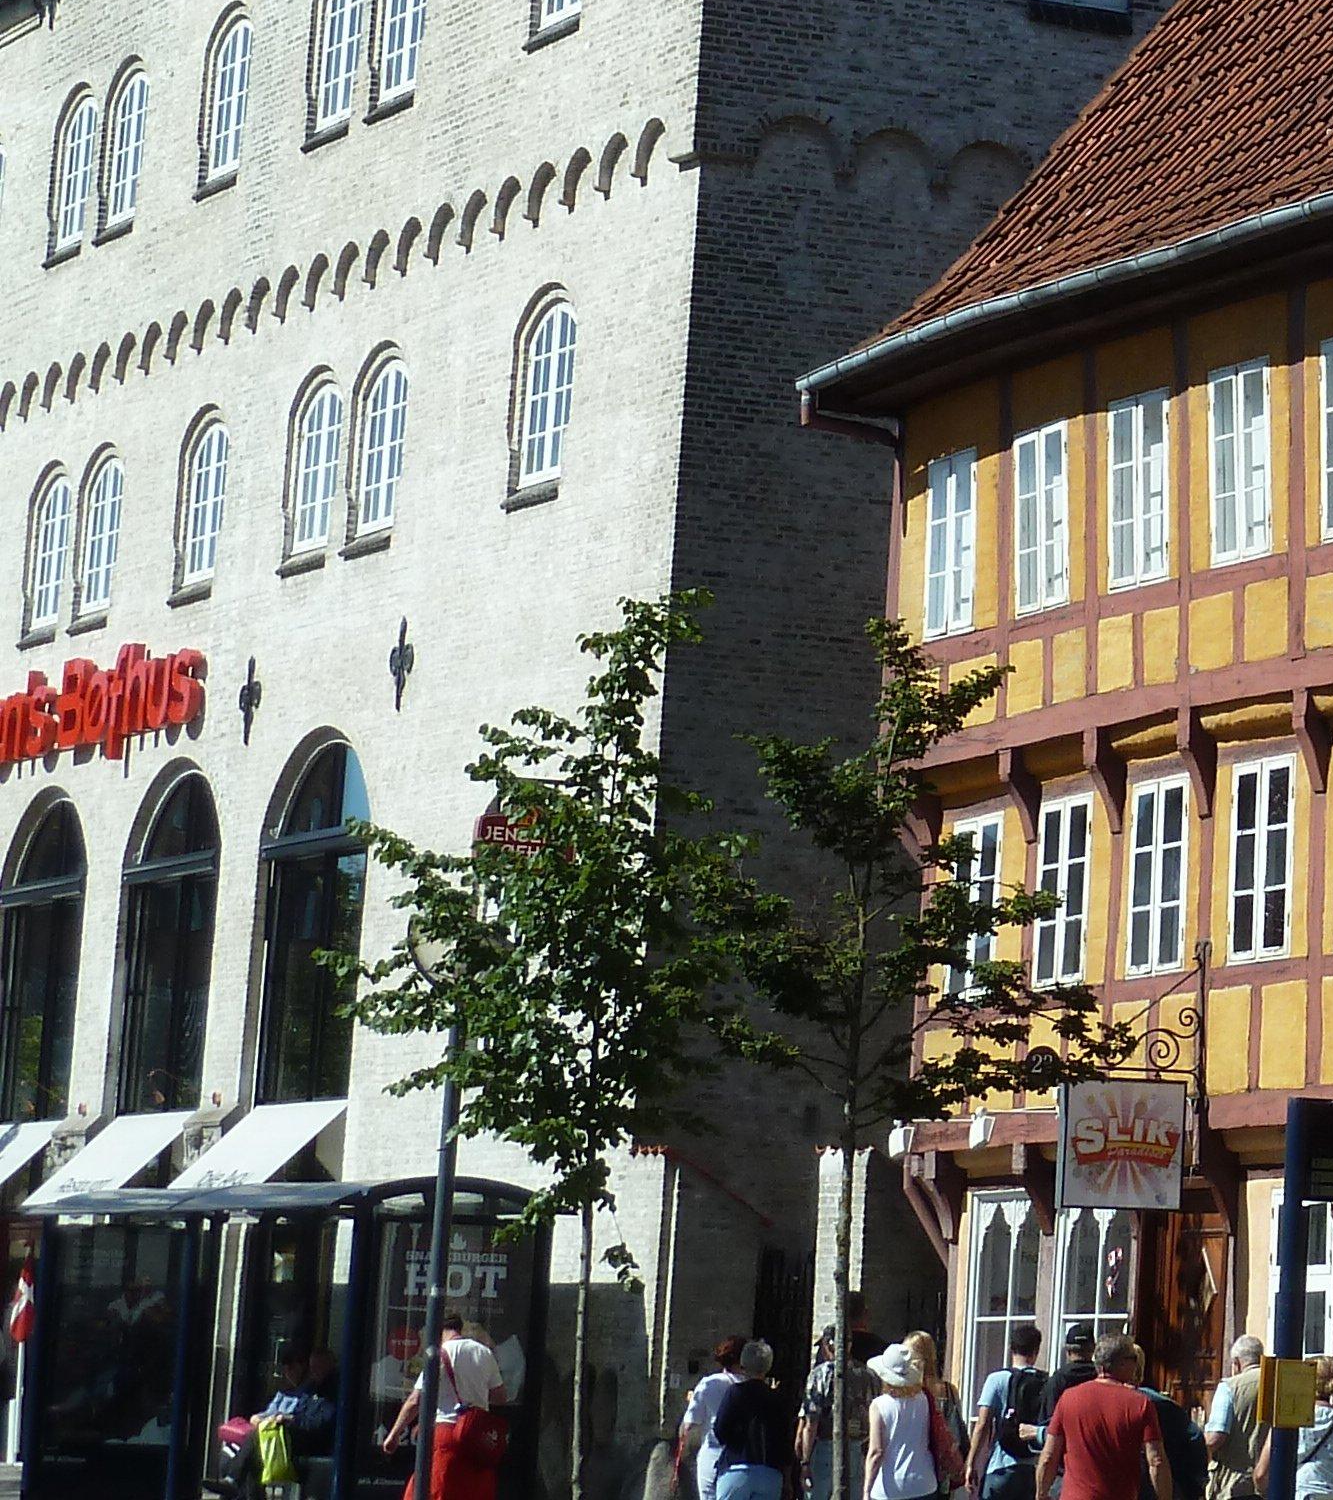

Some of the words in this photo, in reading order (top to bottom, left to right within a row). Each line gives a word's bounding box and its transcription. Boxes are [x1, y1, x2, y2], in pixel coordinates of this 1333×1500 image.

[57, 643, 208, 760] Bøfhus
[1076, 1117, 1174, 1154] SLIK
[403, 1264, 507, 1298] HOT
